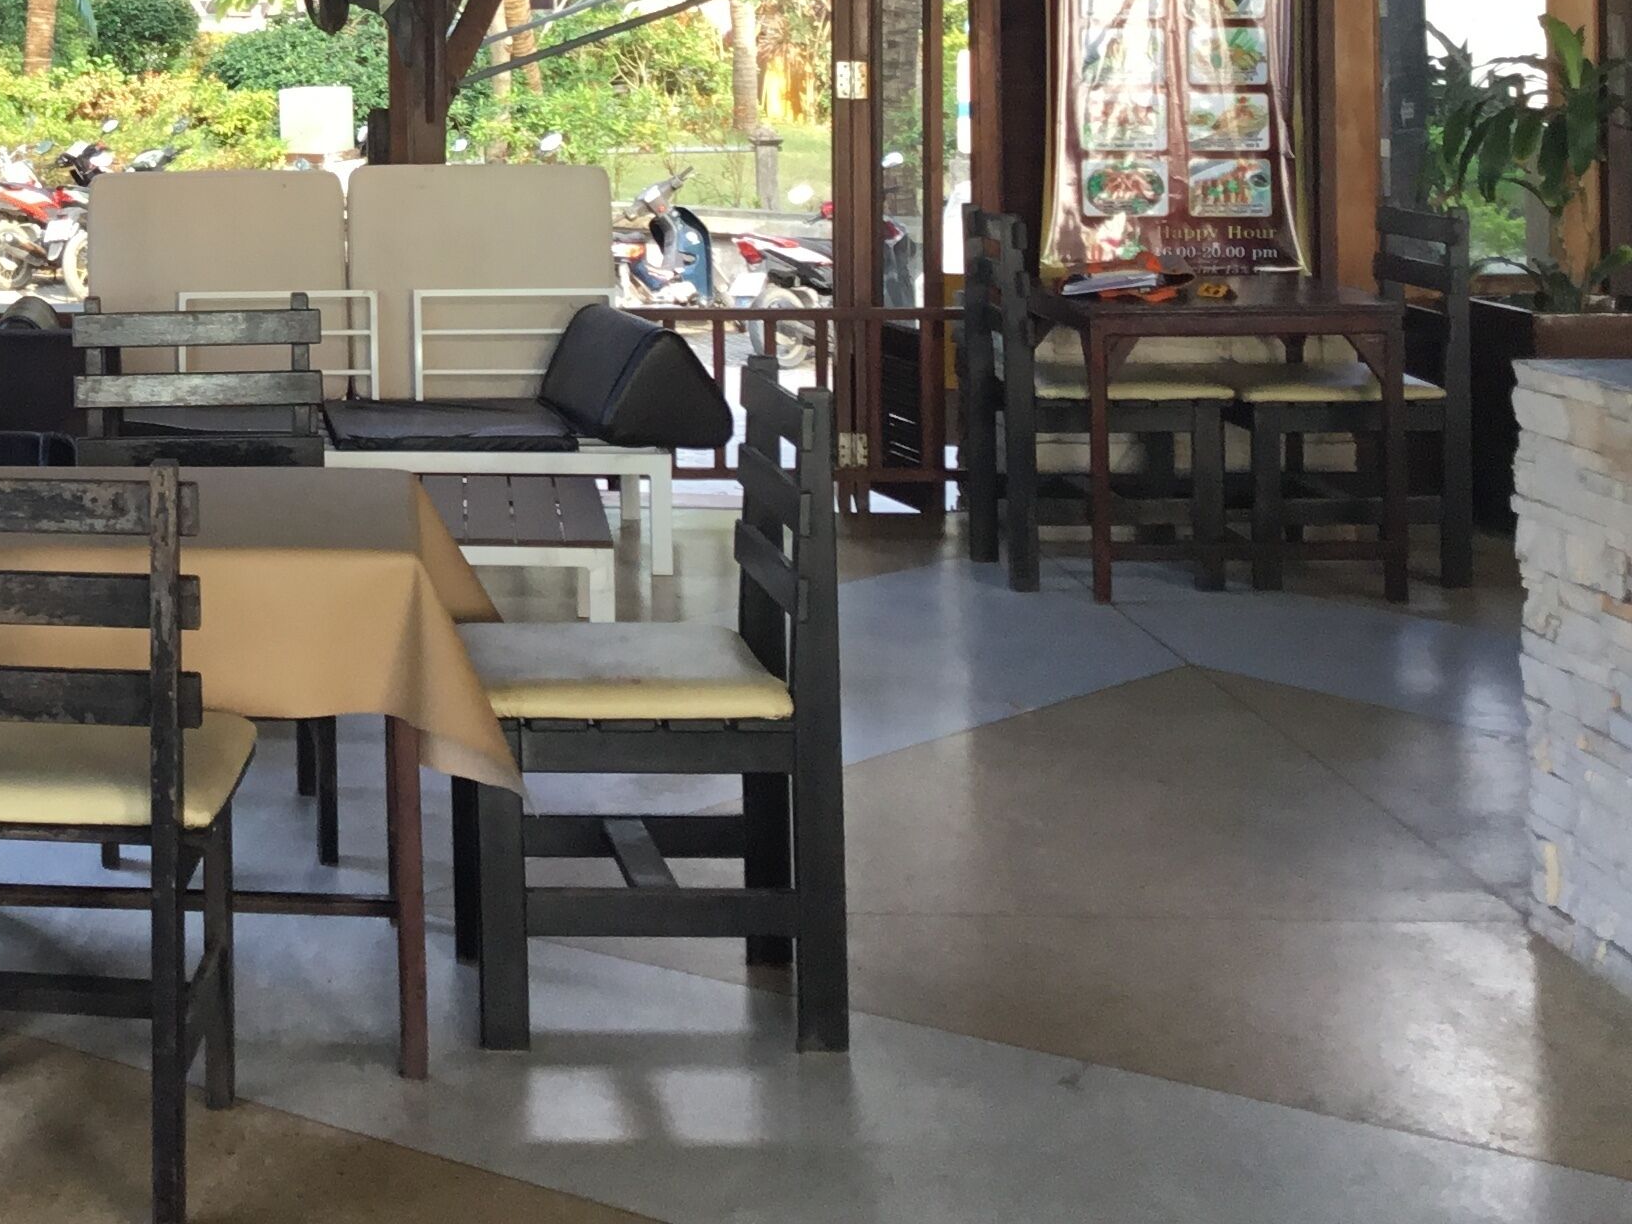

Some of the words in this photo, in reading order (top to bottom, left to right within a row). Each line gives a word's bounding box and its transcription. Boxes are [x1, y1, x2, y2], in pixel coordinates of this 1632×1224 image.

[1158, 224, 1218, 242] Happy
[1227, 224, 1277, 240] Hour
[1154, 245, 1246, 258] 1600-20.00
[1252, 248, 1279, 261] pm
